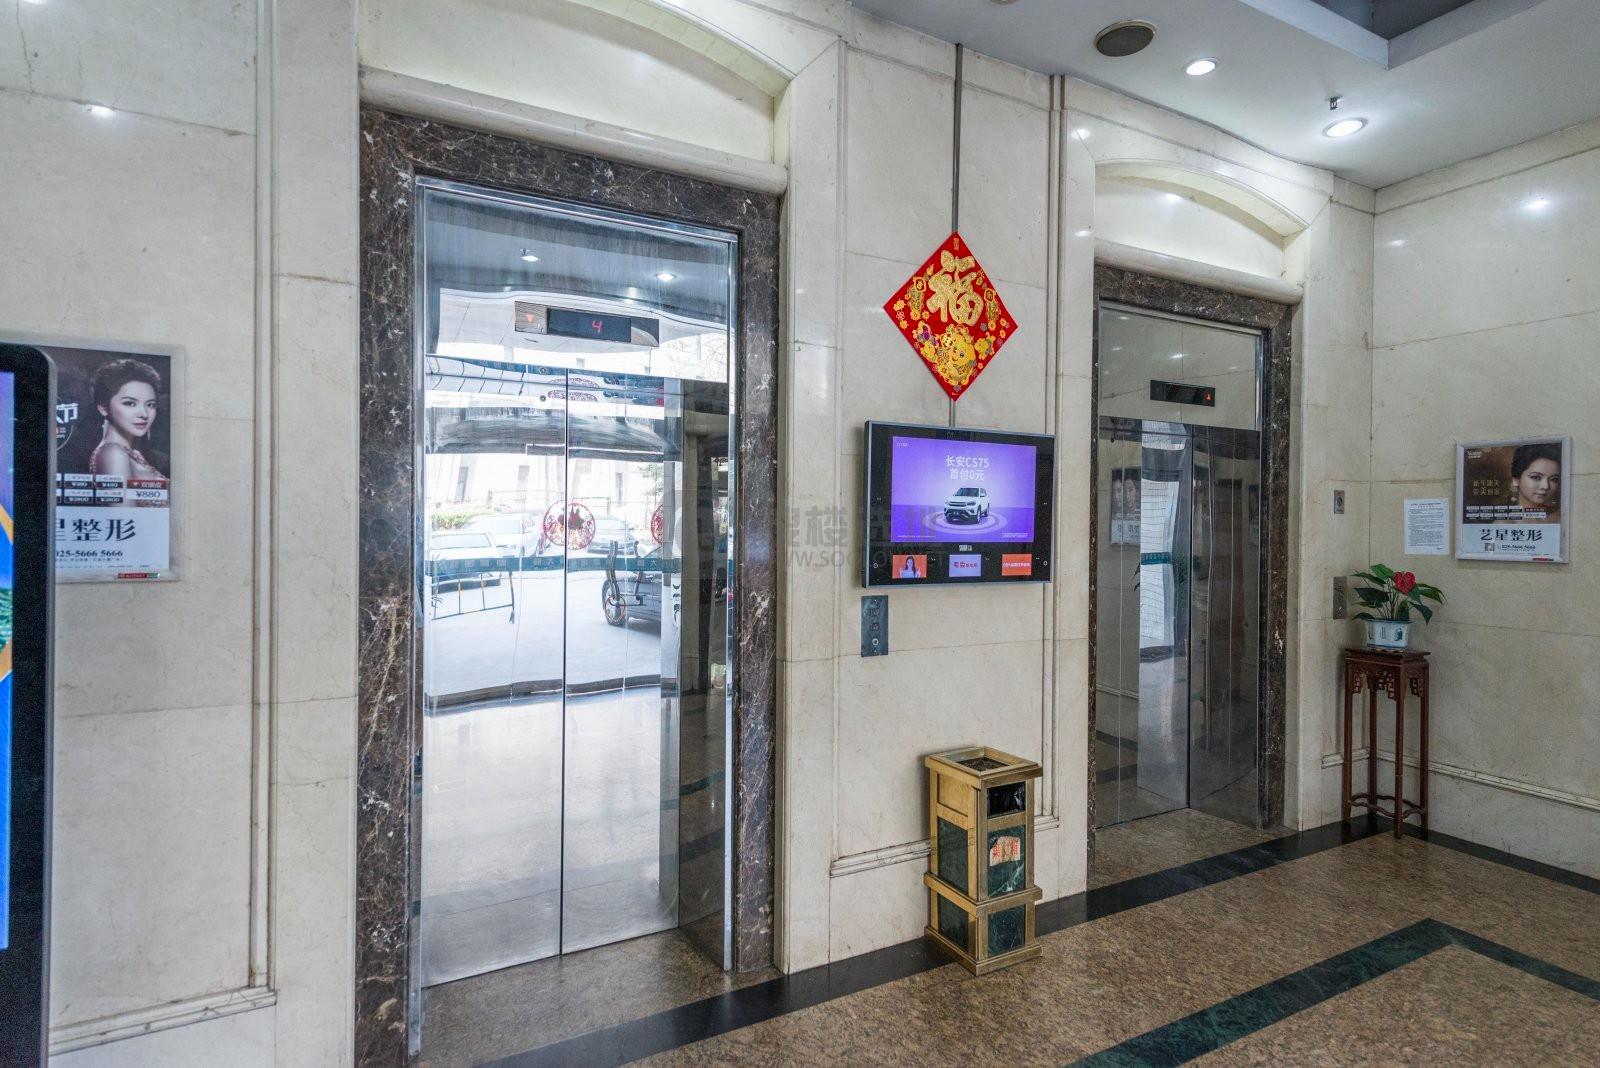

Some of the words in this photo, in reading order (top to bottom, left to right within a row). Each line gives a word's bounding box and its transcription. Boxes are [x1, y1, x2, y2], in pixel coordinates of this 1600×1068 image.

[926, 250, 984, 327] 福
[592, 319, 602, 334] 4
[946, 455, 990, 469] 长安CS75
[1480, 529, 1542, 541] 艺星整形
[100, 549, 123, 557] 5666
